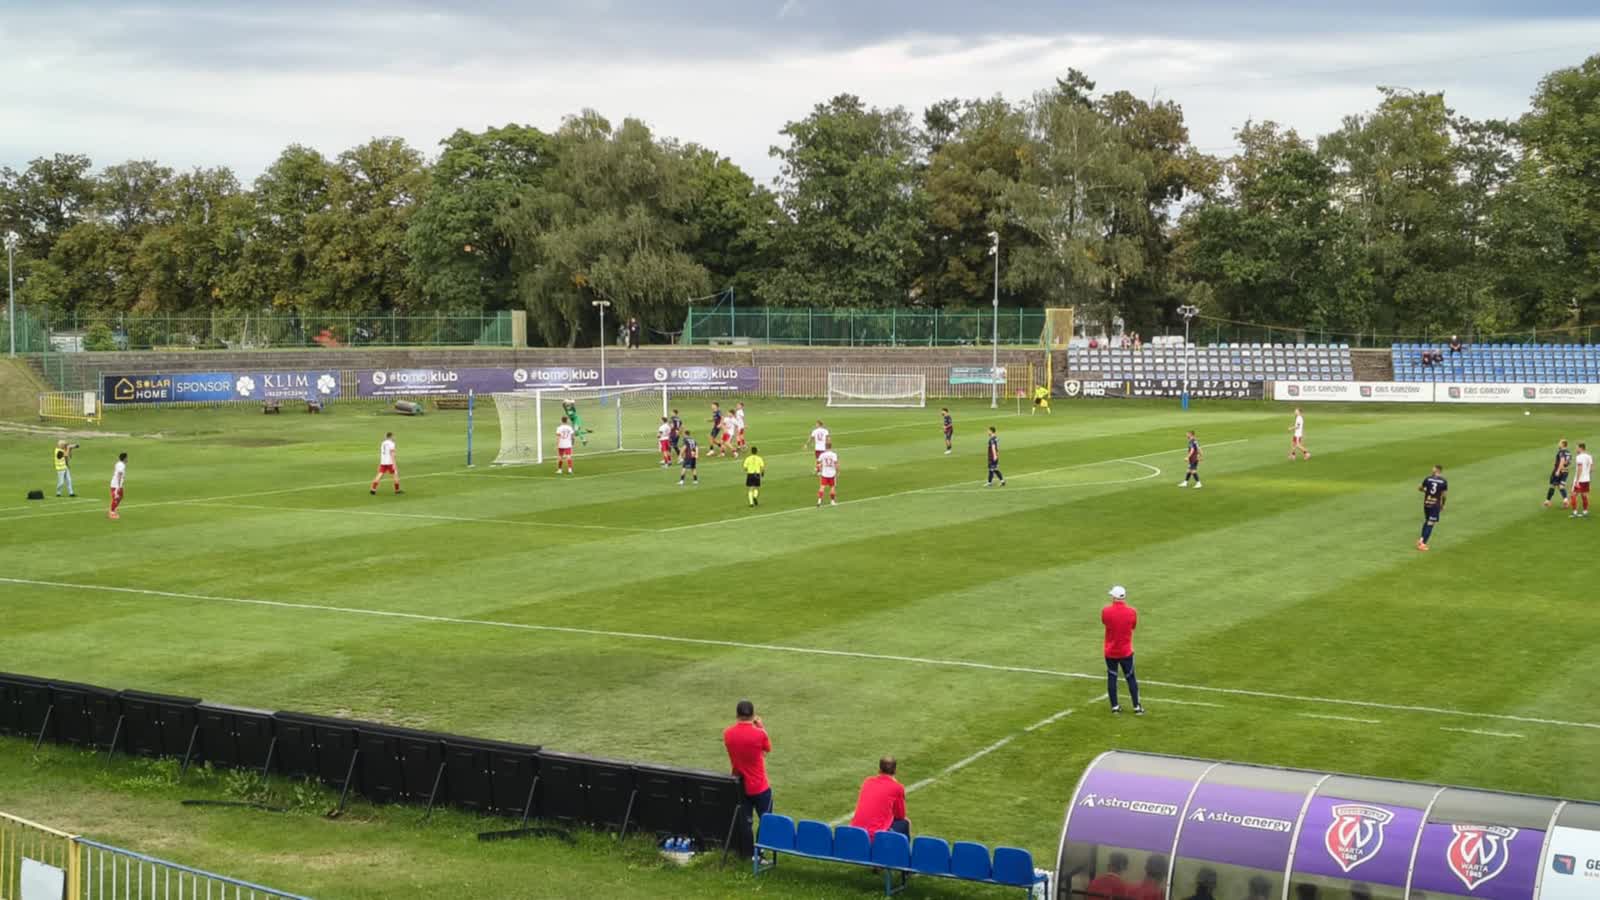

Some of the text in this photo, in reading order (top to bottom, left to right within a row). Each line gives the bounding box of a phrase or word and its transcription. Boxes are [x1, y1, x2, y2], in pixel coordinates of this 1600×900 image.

[136, 379, 171, 388] SOLAR
[264, 374, 309, 387] KLIM
[177, 382, 230, 392] SPONSOR
[136, 390, 167, 399] HOME
[1430, 482, 1438, 495] 3
[1461, 863, 1489, 873] WARTA
